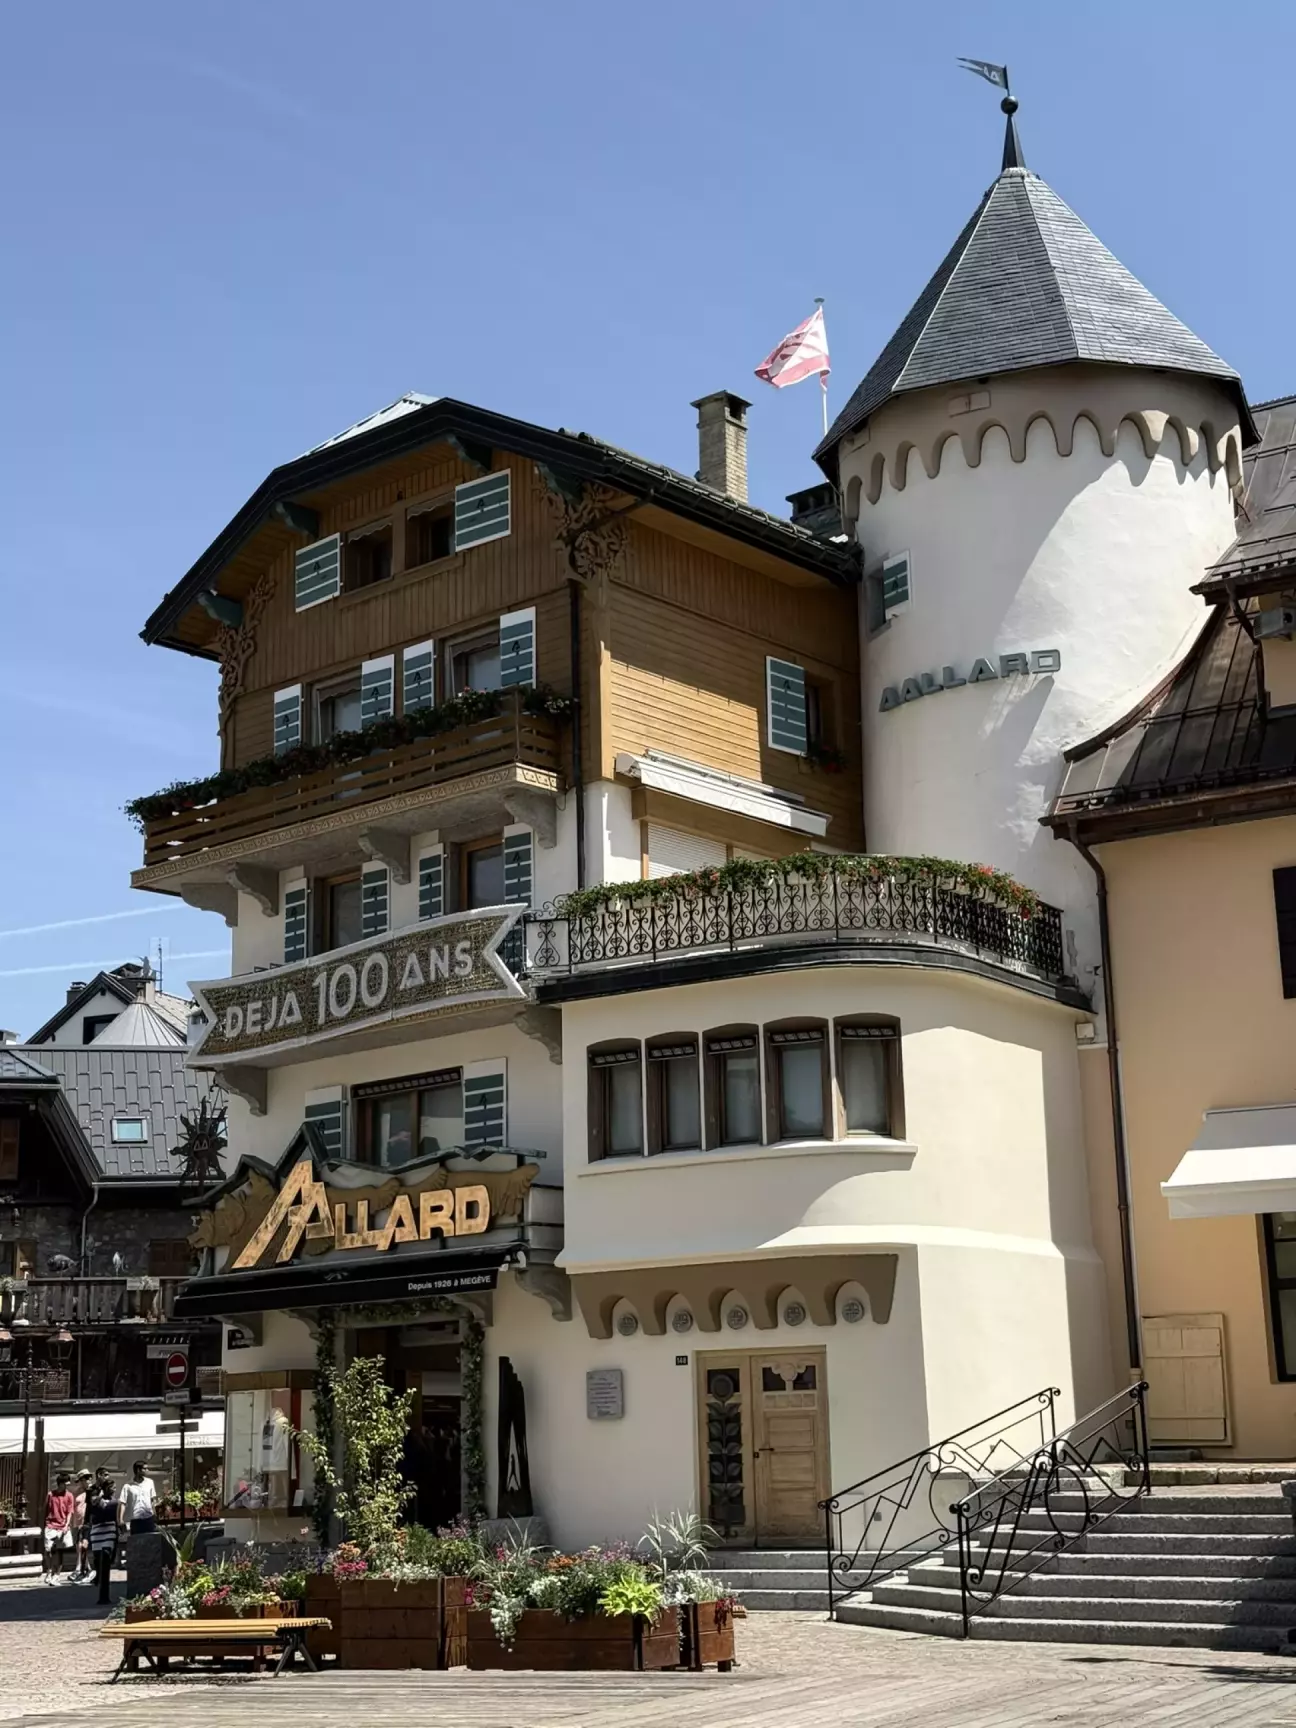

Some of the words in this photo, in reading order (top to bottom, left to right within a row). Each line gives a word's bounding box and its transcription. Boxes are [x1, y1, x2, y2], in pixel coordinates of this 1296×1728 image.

[224, 990, 302, 1038] DEJA
[312, 951, 389, 1025] 100
[400, 940, 474, 990] ANS
[408, 1281, 432, 1291] Depuis
[460, 1275, 491, 1285] MEGÈVE
